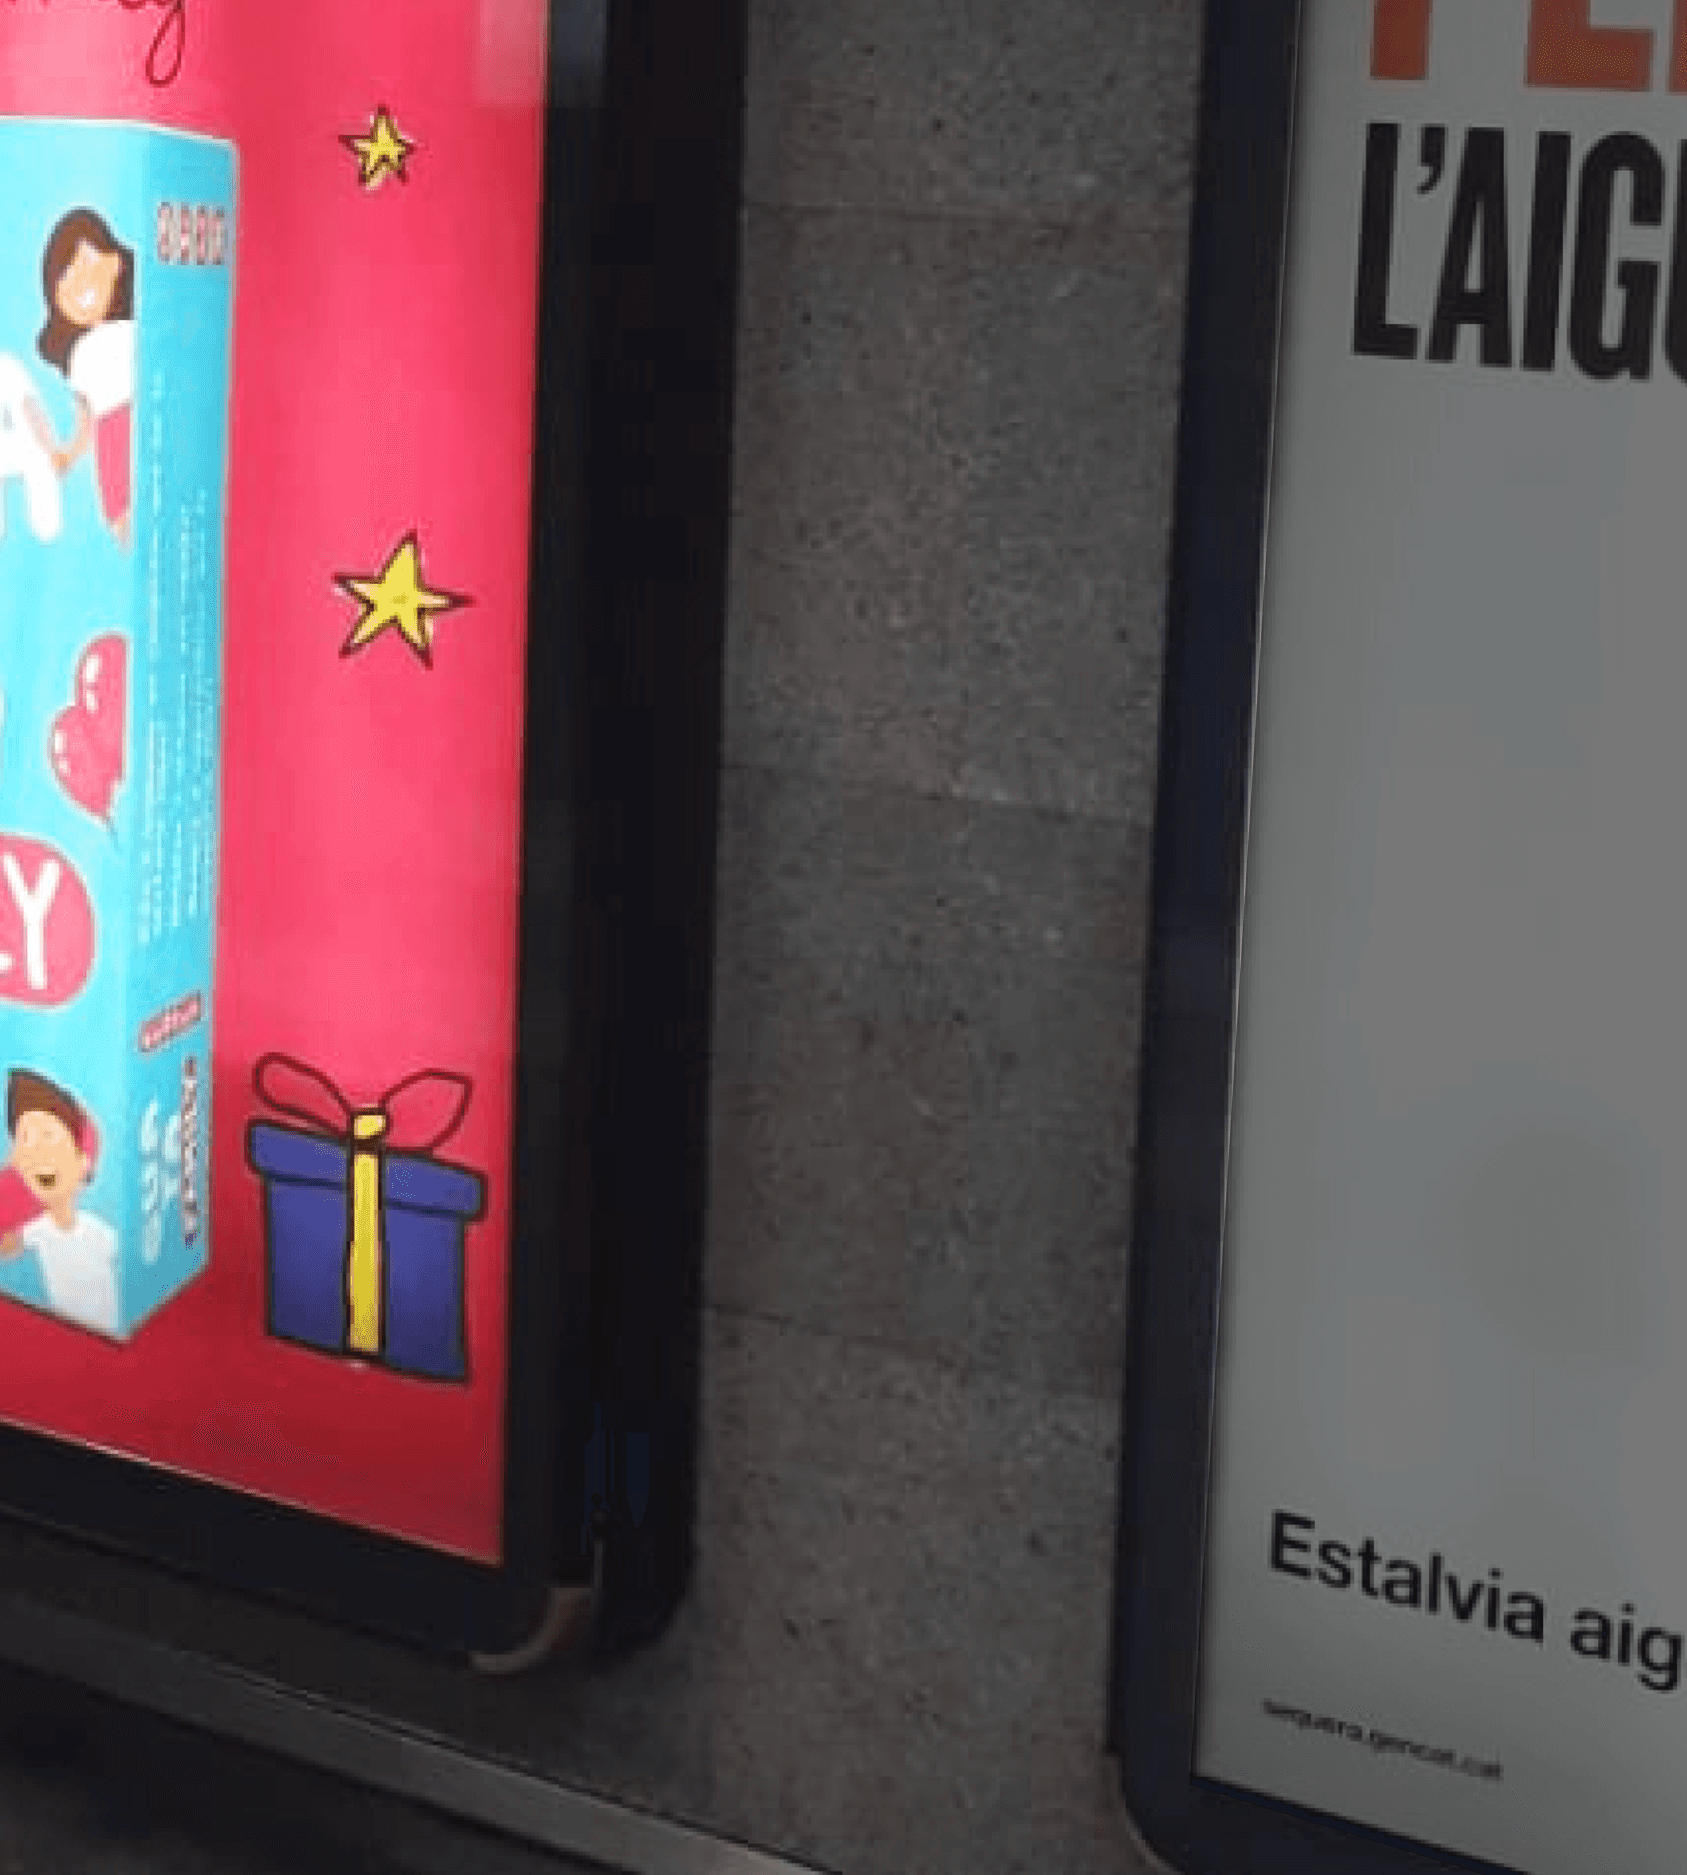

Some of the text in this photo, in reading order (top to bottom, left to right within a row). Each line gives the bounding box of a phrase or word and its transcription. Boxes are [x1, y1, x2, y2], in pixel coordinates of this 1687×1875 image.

[1351, 120, 1687, 382] L'AIG
[1270, 1509, 1684, 1694] Estalvia aig
